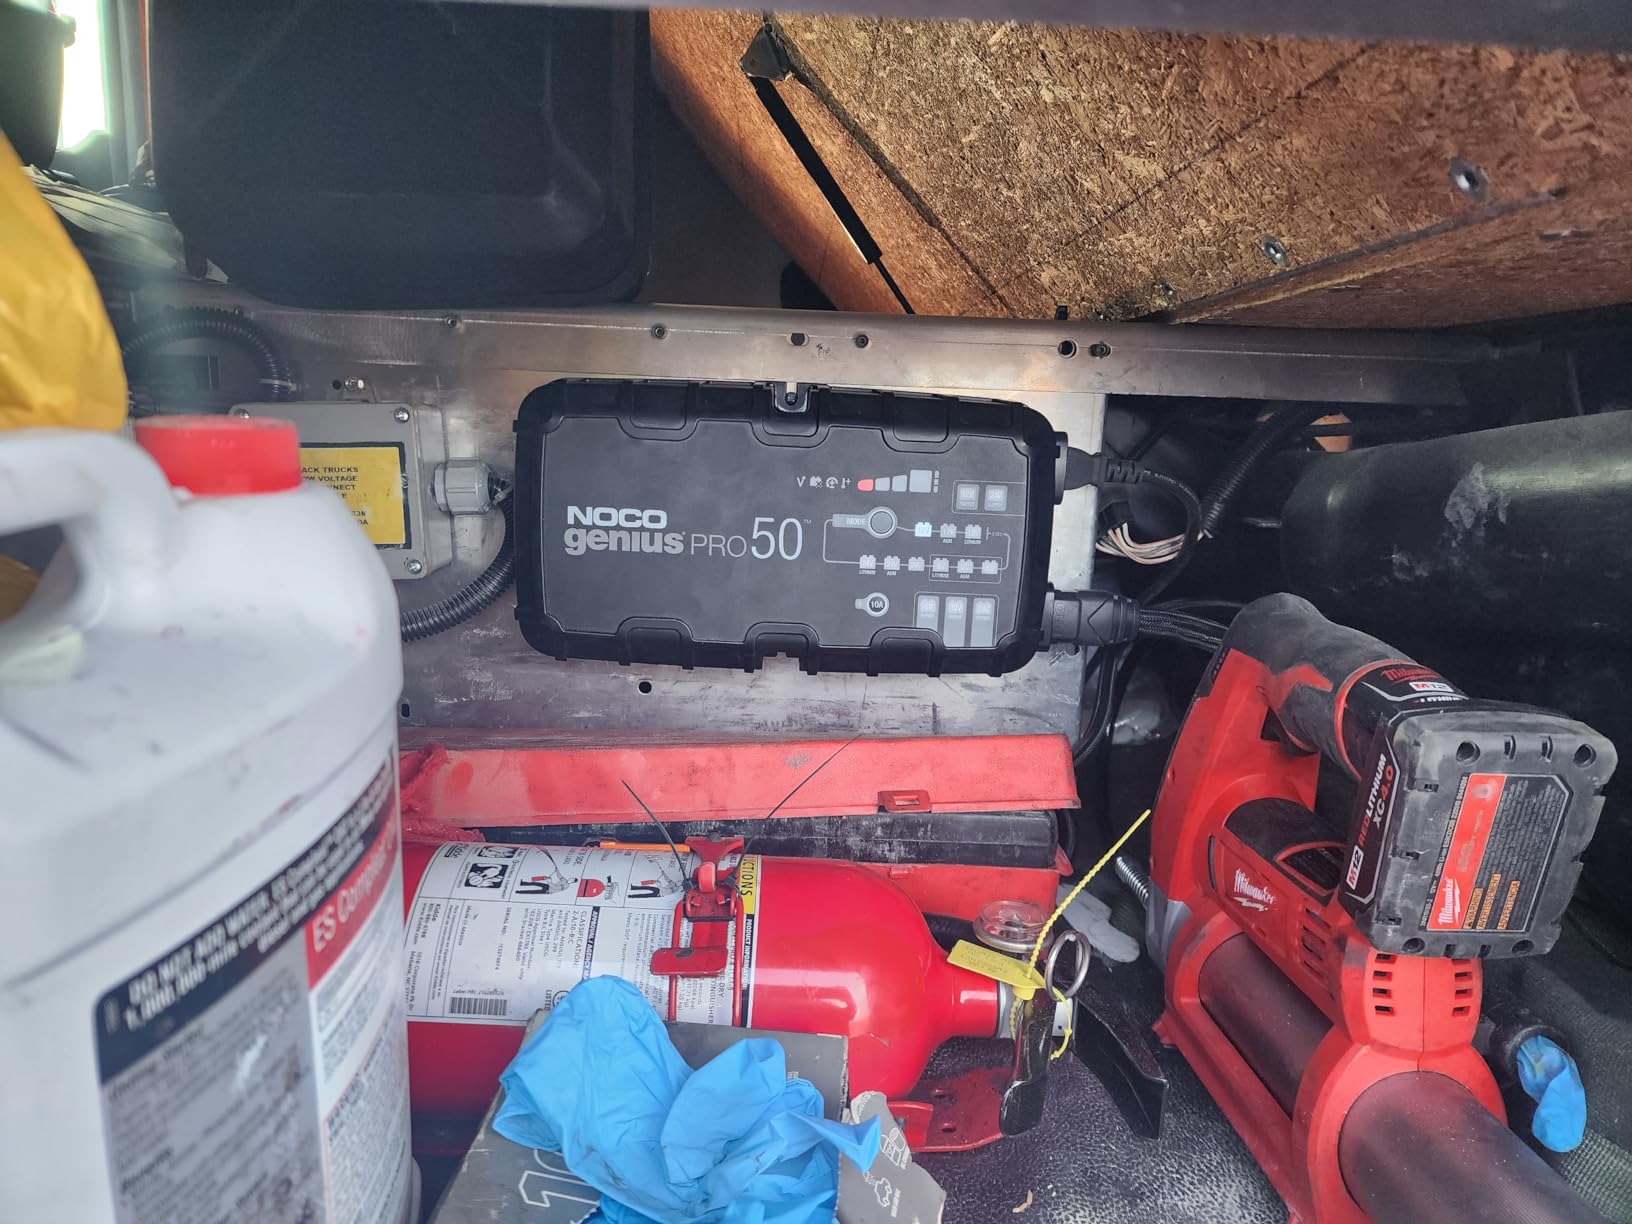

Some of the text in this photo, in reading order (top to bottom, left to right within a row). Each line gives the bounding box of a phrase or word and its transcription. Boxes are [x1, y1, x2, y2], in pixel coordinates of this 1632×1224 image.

[567, 505, 668, 529] NOCO
[847, 517, 867, 526] MODE
[563, 527, 685, 556] genius
[691, 533, 747, 557] PRO
[870, 600, 884, 609] 10A
[1348, 753, 1387, 885] M12 REDLITHIUM
[1233, 868, 1277, 905] Milwaukee
[1437, 877, 1454, 925] Milwaukee
[1477, 873, 1502, 929] AVERTISSEMENT
[431, 903, 441, 922] Kidde
[1467, 888, 1484, 921] WARNING
[1498, 880, 1520, 929] ADVERTENCIA
[312, 905, 337, 952] ES
[588, 910, 599, 940] APPROVAL
[741, 918, 753, 990] PRODUCT INFORMATION
